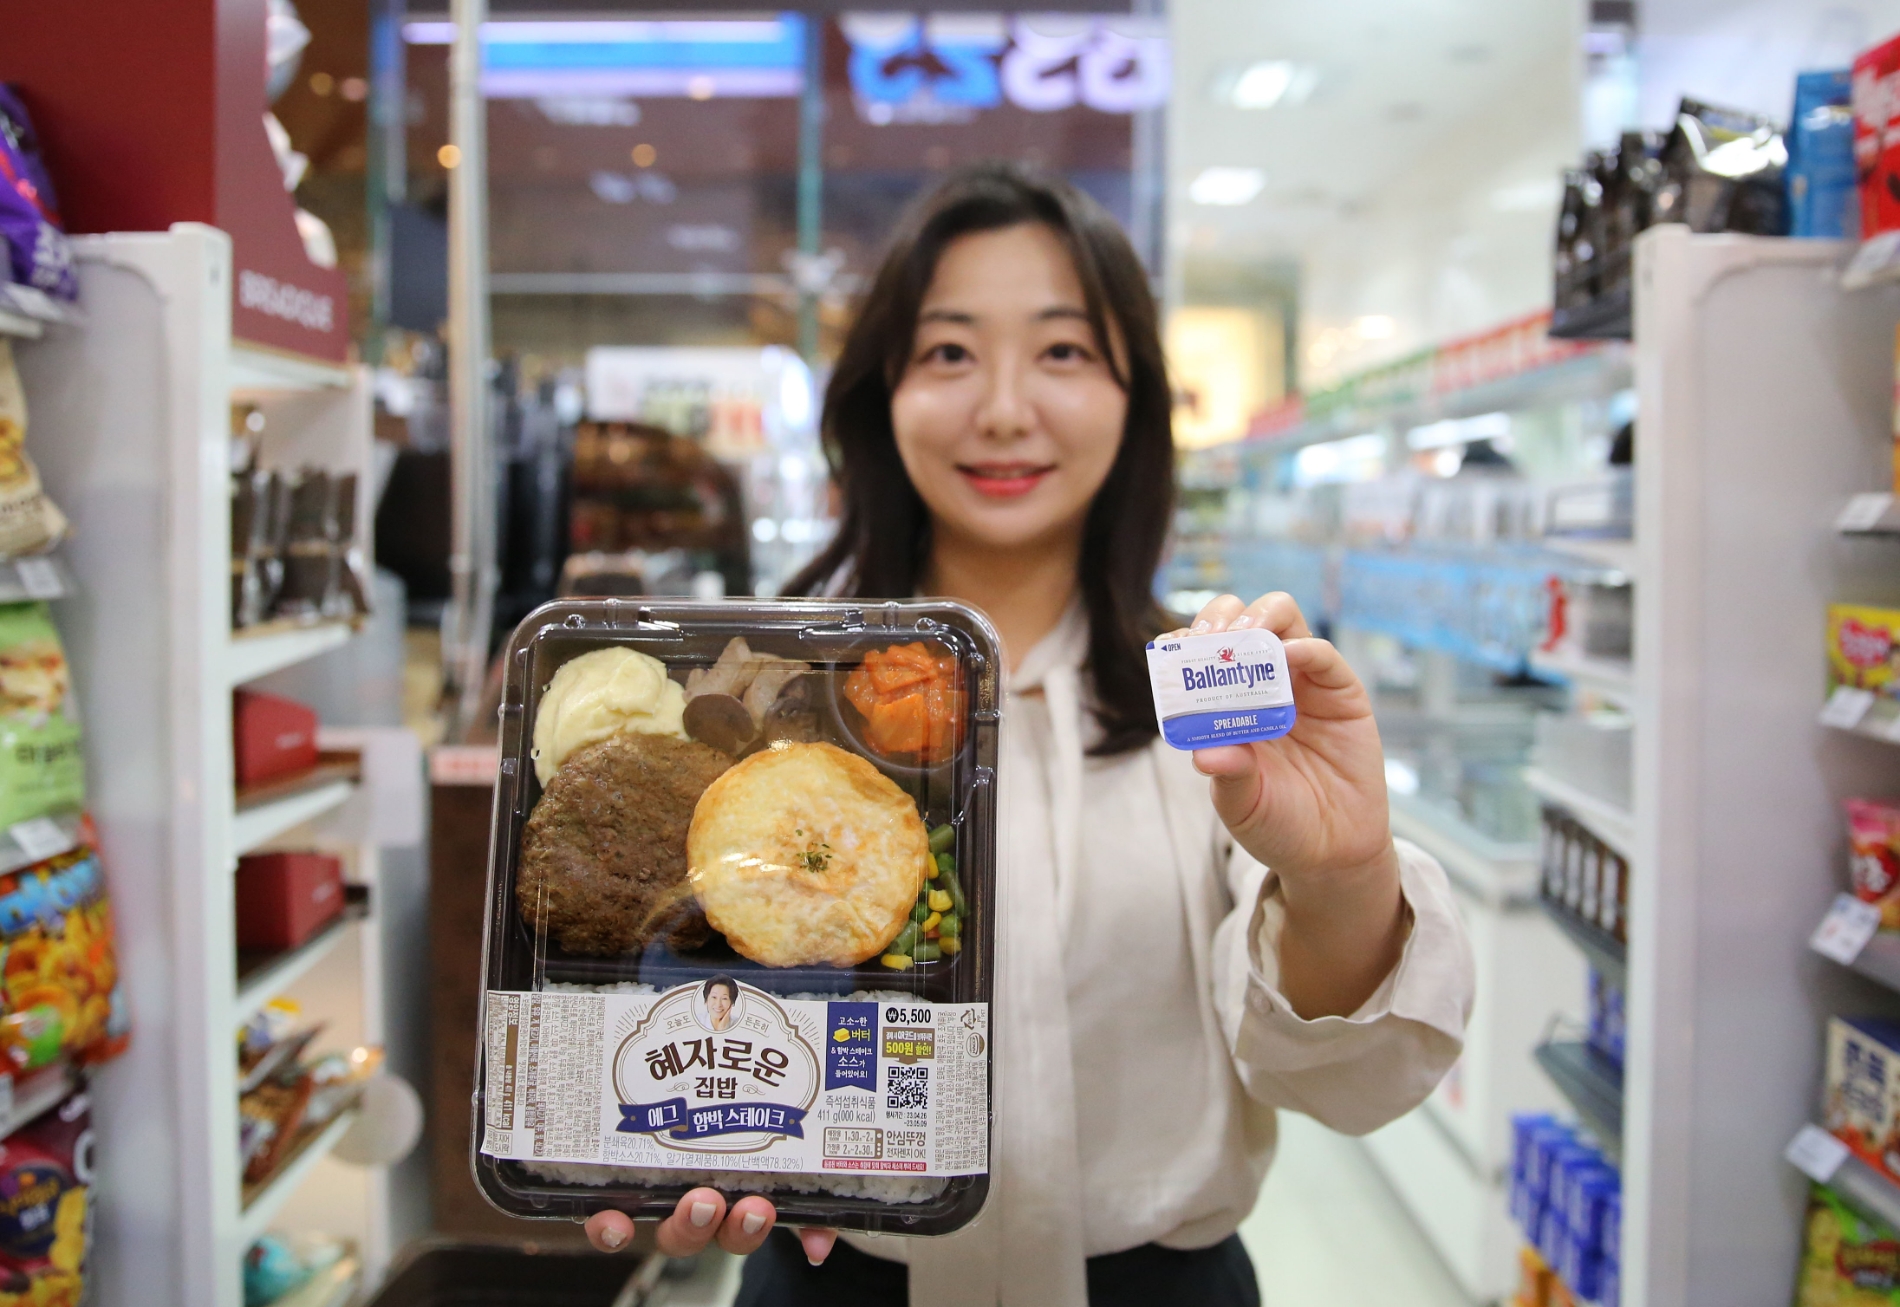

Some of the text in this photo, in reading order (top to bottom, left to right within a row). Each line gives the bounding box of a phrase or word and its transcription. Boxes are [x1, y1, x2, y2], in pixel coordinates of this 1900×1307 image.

[1168, 643, 1182, 652] OPEN
[1182, 662, 1276, 691] Ballantyne
[1196, 695, 1222, 703] PRODUCT
[1235, 690, 1269, 699] AUSTRALIA
[1213, 714, 1258, 731] SPREADABLE
[508, 997, 520, 1026] 영양정보
[666, 1015, 770, 1033] 오늘도 든든히
[851, 1029, 872, 1042] 버터
[831, 1047, 837, 1055] &
[886, 1041, 932, 1056] 500원 할인!
[644, 1036, 790, 1088] 혜자로운
[838, 1056, 867, 1068] 소스가
[835, 1069, 869, 1080] 들어있어요!
[694, 1076, 738, 1100] 집밥
[503, 1100, 514, 1111] 411
[825, 1095, 876, 1110] 즉석섭취식품
[502, 1113, 512, 1128] kcal
[648, 1105, 786, 1133] 에그 함박 스테이크
[817, 1109, 830, 1122] 411
[856, 1110, 876, 1124] kcal)
[886, 1130, 926, 1147] 안심뚜껑
[886, 1147, 927, 1159] 전자렌지 OK!
